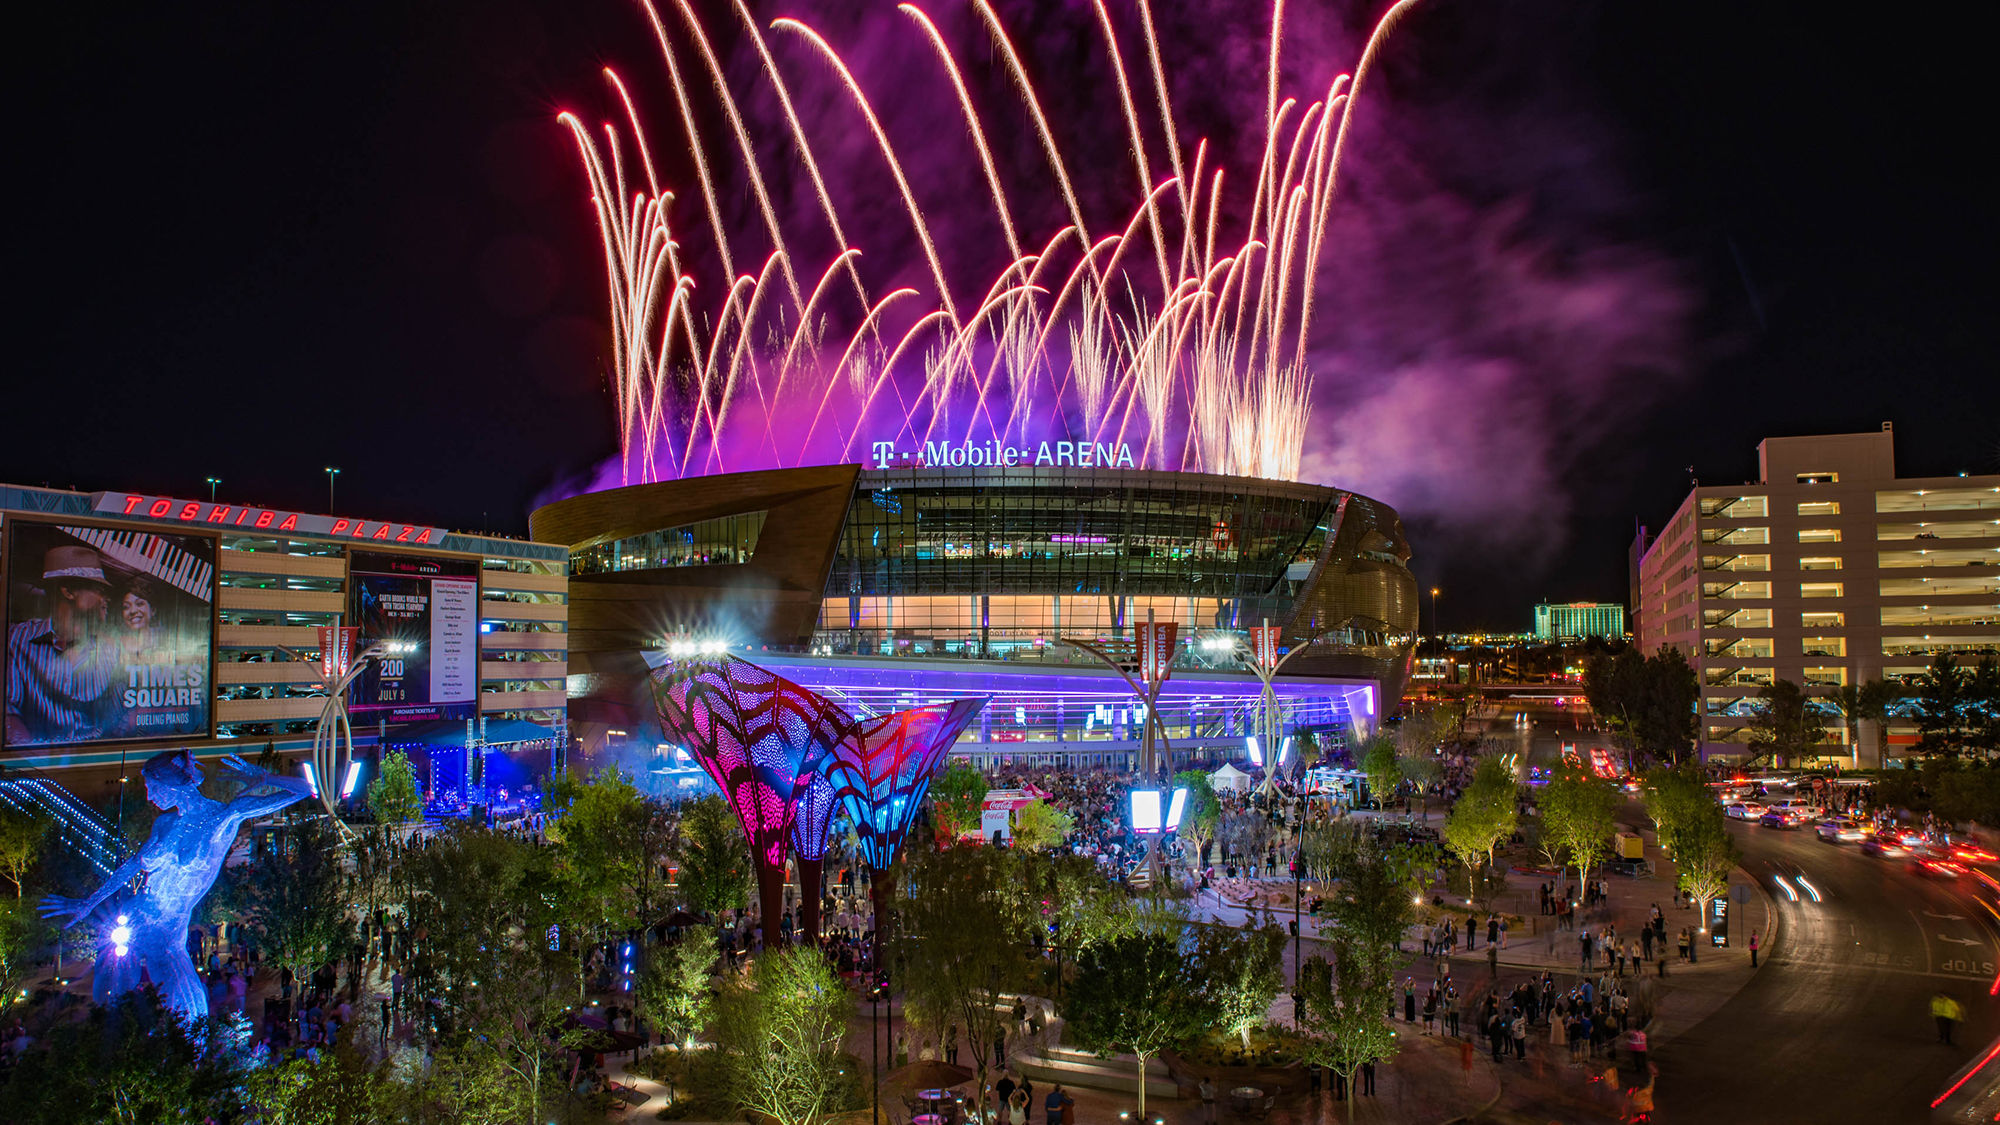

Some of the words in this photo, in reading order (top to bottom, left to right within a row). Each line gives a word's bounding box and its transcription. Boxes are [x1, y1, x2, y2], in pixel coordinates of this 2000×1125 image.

[1035, 441, 1135, 468] ARENA
[123, 496, 299, 531] TOSHIBA
[330, 519, 433, 544] PLAZA
[341, 629, 349, 670] TOSHIBA
[1157, 625, 1166, 674] TOSHIBA
[125, 664, 202, 688] TIMES
[381, 660, 404, 677] 200
[123, 687, 202, 708] SQUARE
[379, 690, 397, 701] JULY
[400, 690, 405, 700] 9
[136, 714, 165, 726] DUELING
[165, 712, 190, 725] PIANOS
[989, 801, 1014, 810] Coca-Cola
[984, 812, 1005, 820] Coca-Cola
[1942, 960, 1995, 975] STOP
